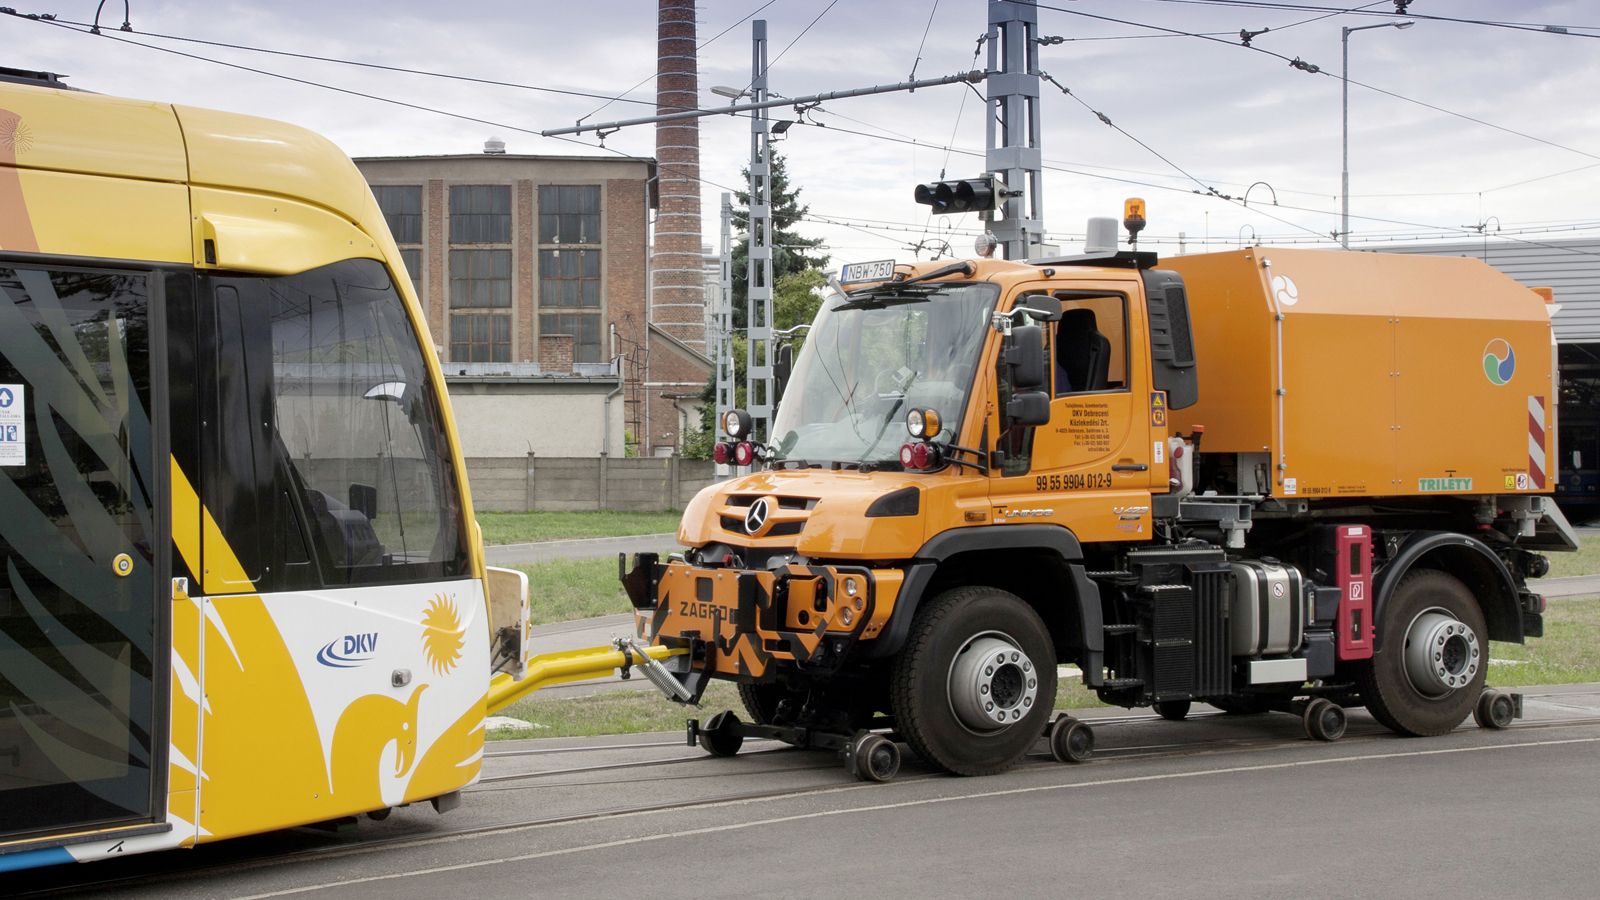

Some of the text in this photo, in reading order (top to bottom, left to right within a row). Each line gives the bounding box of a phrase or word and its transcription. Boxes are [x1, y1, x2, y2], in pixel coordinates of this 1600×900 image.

[848, 262, 892, 279] NBW-750
[1072, 409, 1109, 417] DKV Debreceni
[1036, 472, 1112, 491] 99 55 9904 012-9
[1419, 478, 1472, 490] TRILETY
[344, 632, 379, 655] DKV
